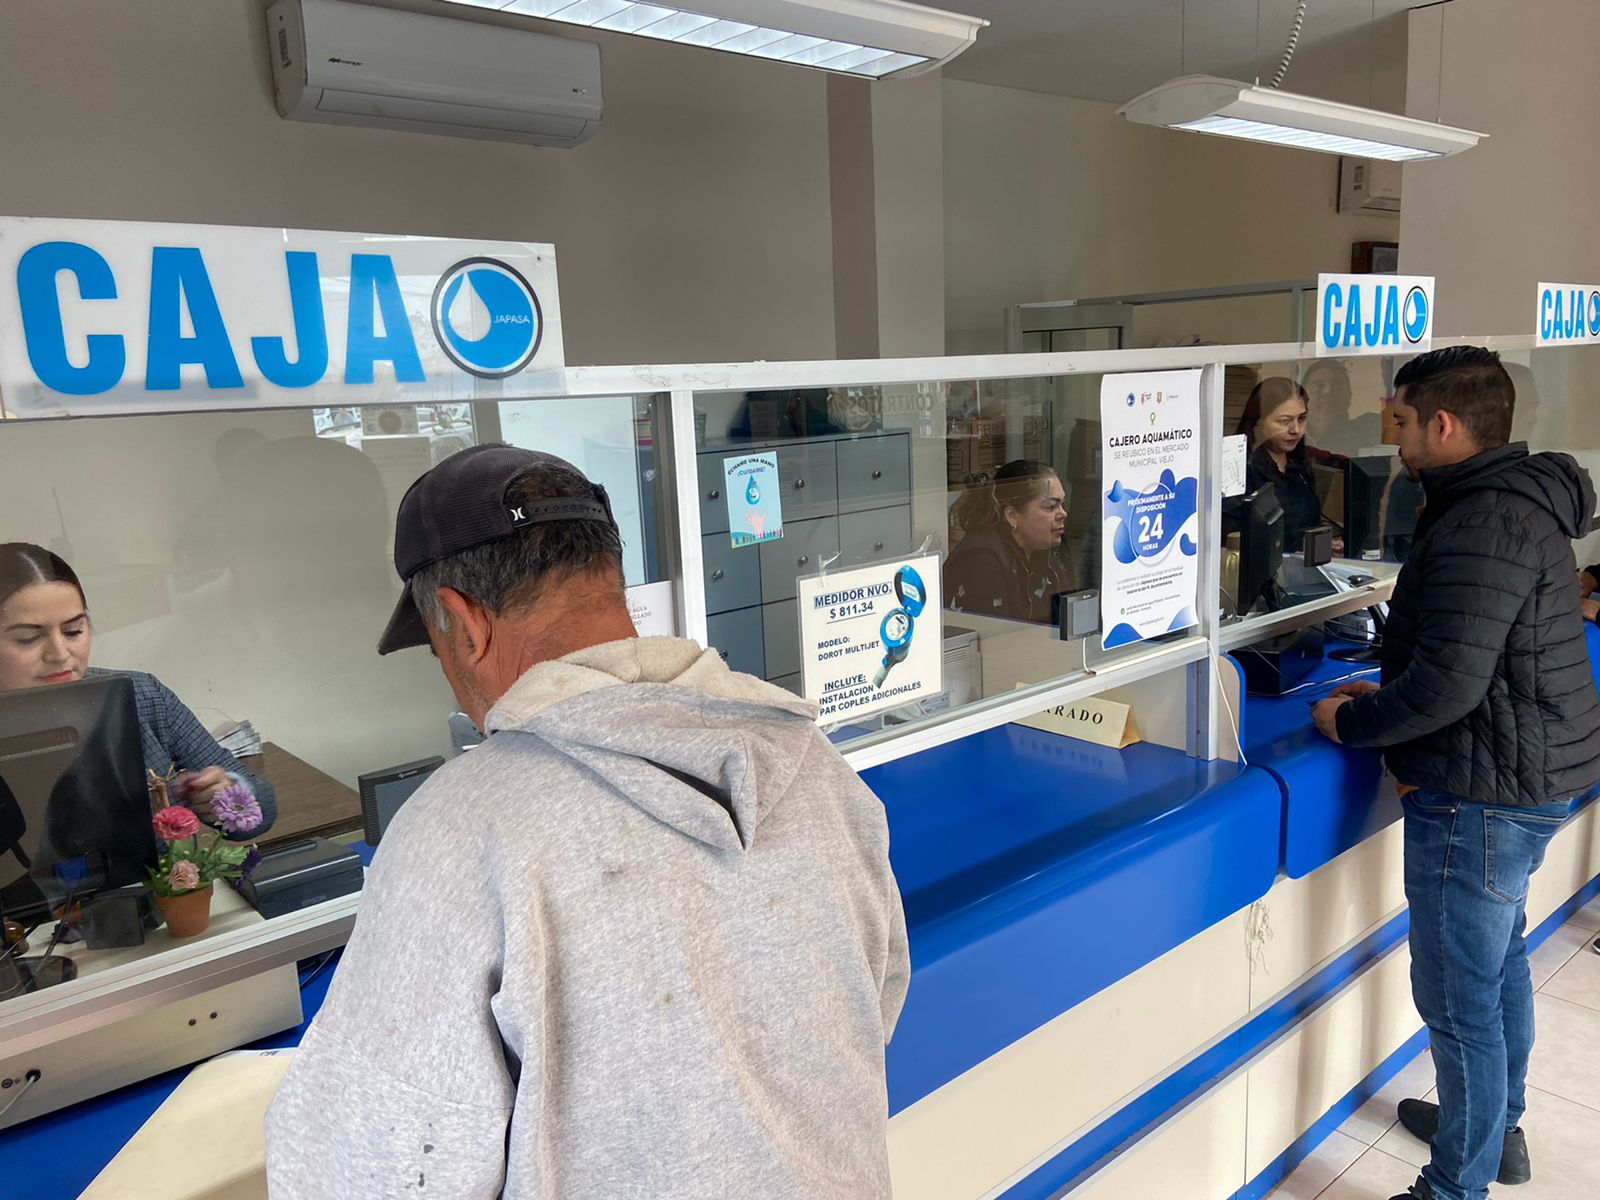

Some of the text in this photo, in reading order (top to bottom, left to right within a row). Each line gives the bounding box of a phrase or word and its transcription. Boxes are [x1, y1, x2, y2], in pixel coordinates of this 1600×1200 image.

[16, 241, 426, 395] CAJA
[494, 314, 531, 324] JAPASA
[1323, 282, 1399, 348] CAJA
[1541, 289, 1585, 340] CAJA
[1109, 428, 1192, 448] CAJERO AQUAMÁTICO
[1162, 443, 1189, 453] MERCADO
[760, 458, 775, 468] MANO
[1159, 455, 1174, 464] VIEJO
[1138, 513, 1163, 543] 24
[1142, 542, 1158, 551] HORAS
[815, 583, 892, 608] MEDIDOR NVO.
[830, 601, 874, 620] $ 811.34
[818, 636, 850, 650] MODELO:
[818, 640, 880, 661] DOROT MULTIJET
[824, 674, 867, 691] INCLUYE:
[819, 684, 874, 705] INSTALACION
[820, 681, 922, 716] PAR COPLES ADICIONALES
